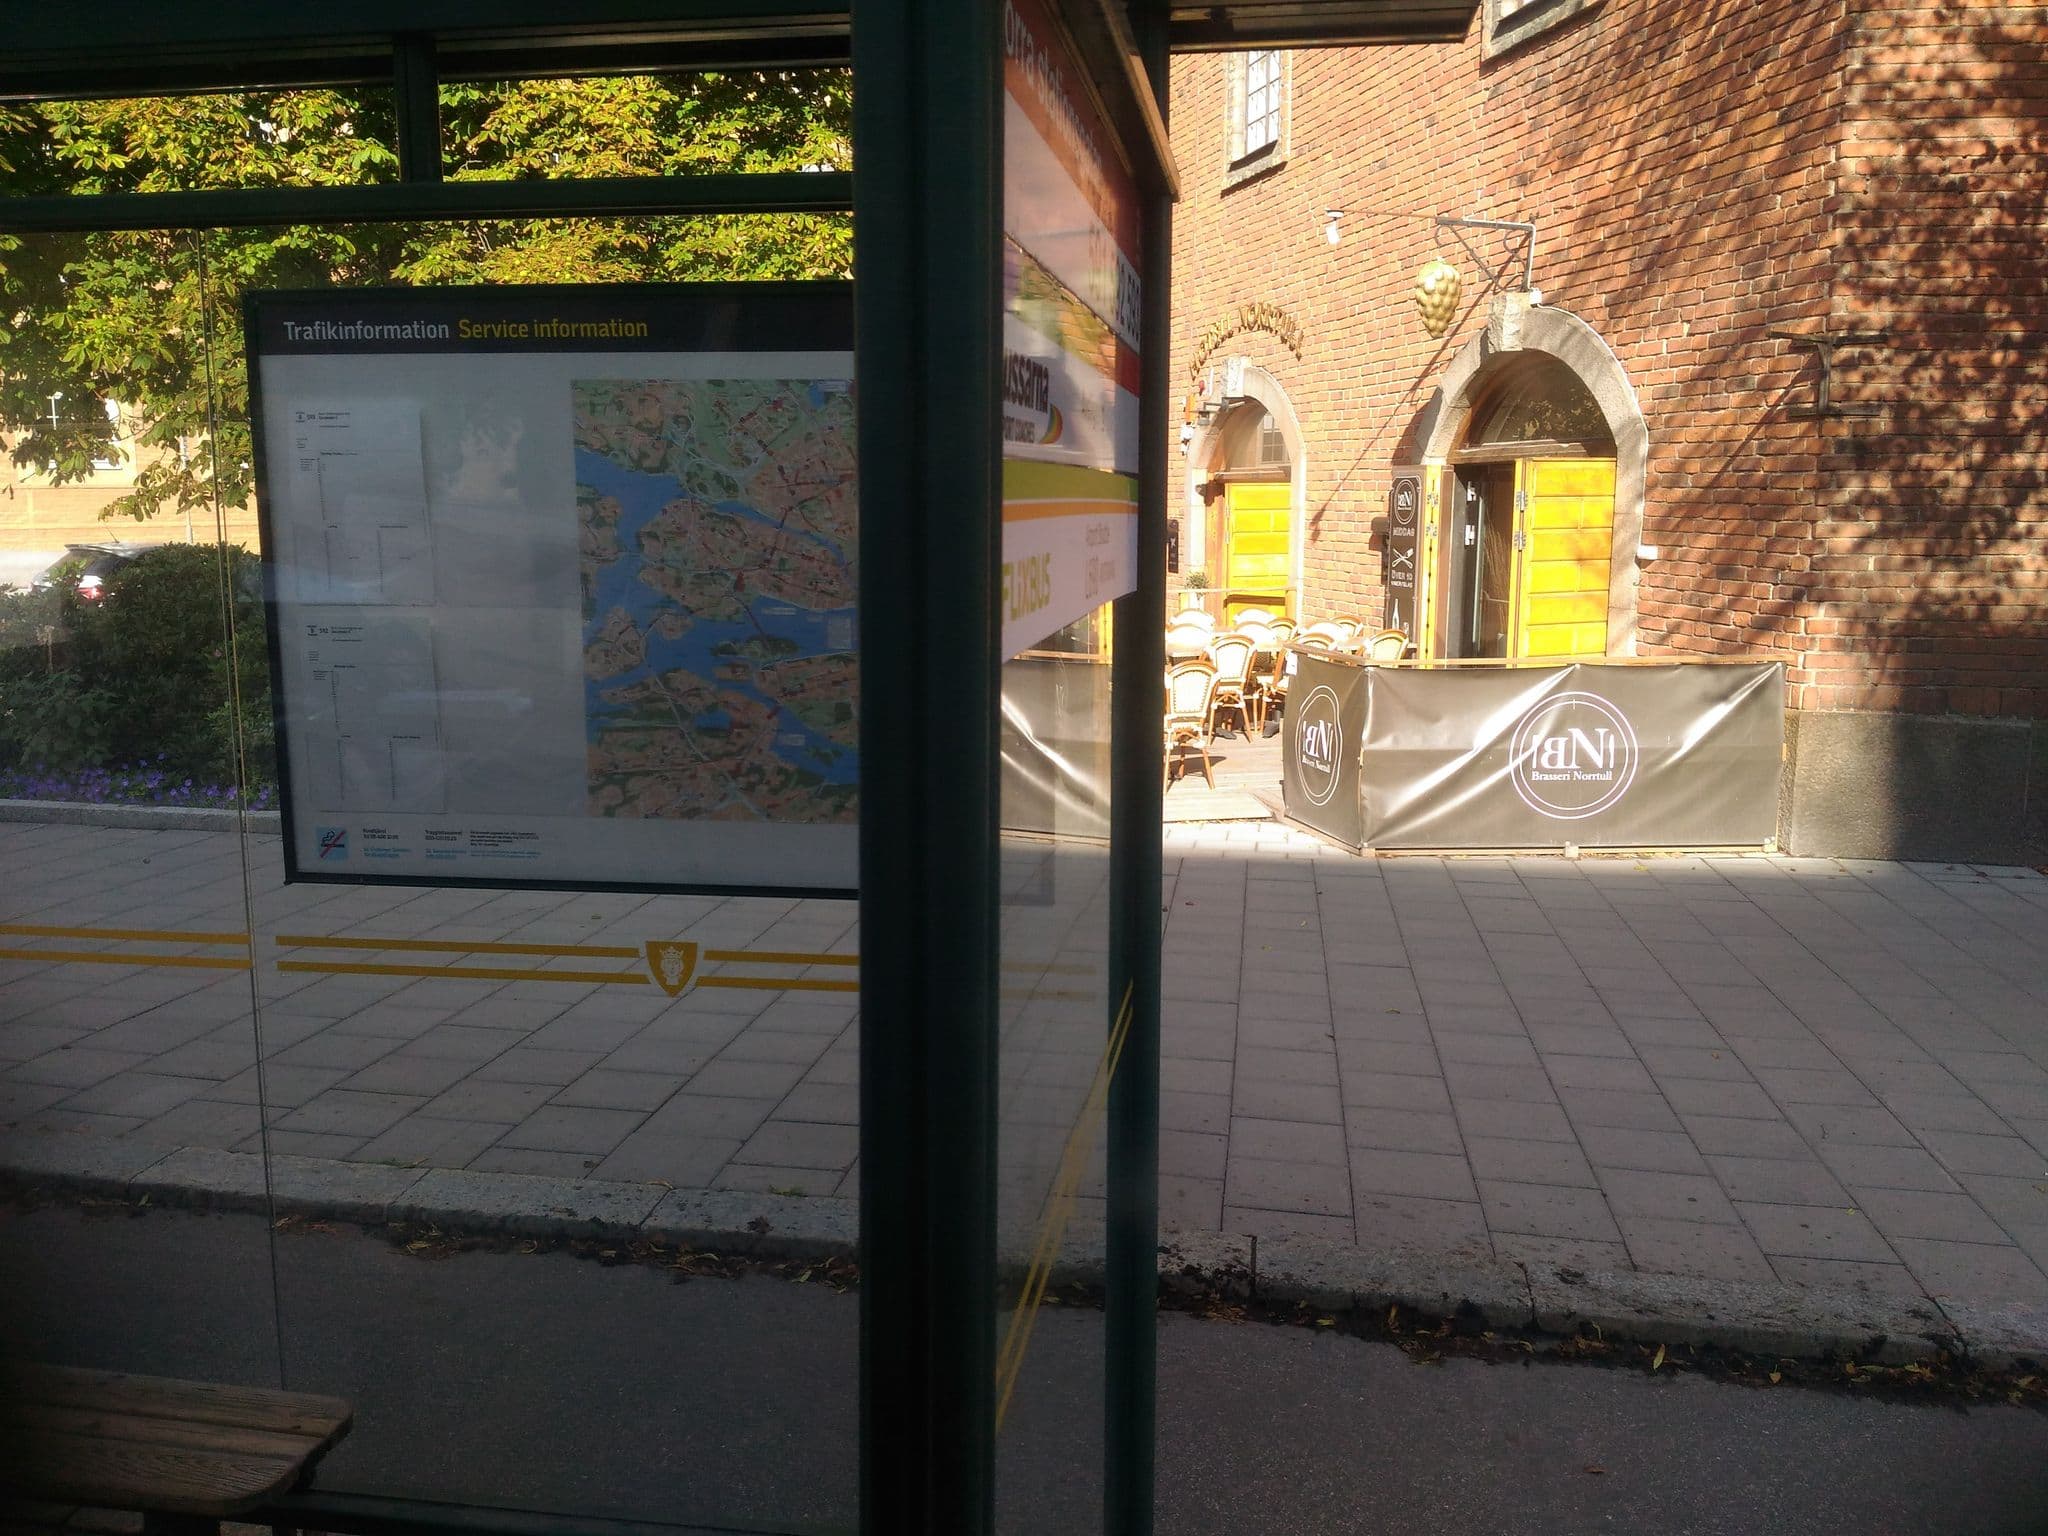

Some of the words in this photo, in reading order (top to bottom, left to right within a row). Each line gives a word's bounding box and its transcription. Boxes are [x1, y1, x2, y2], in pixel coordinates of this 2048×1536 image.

[283, 321, 450, 341] Trafikinformation
[458, 319, 529, 339] Service
[533, 319, 649, 338] information
[1531, 770, 1570, 781] Brasseri
[1573, 770, 1613, 781] Norrtull
